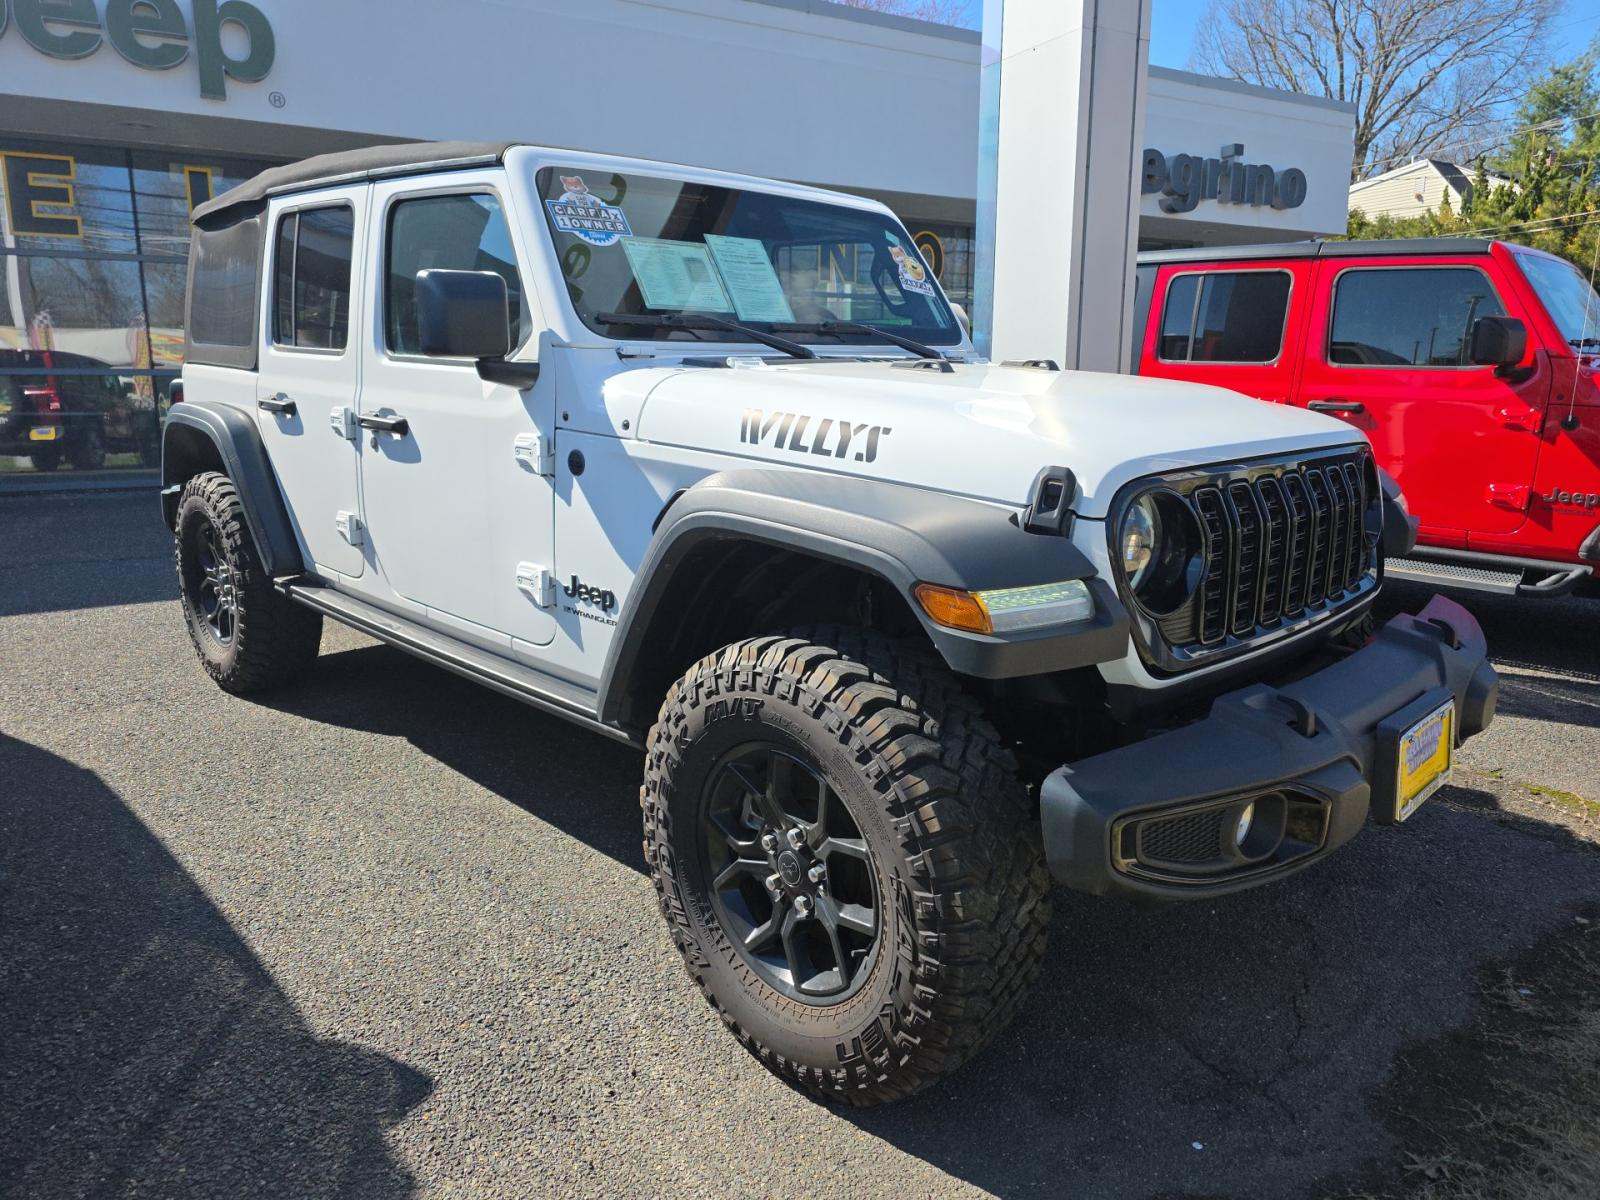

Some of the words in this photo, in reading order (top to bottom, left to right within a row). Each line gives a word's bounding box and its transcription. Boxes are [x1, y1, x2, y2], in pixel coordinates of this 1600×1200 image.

[0, 0, 276, 101] eep
[554, 205, 620, 220] CARFAX
[740, 408, 893, 463] WILLYS
[1542, 487, 1598, 510] Jeep
[563, 574, 615, 612] Jeep
[571, 608, 618, 627] WRANGLER
